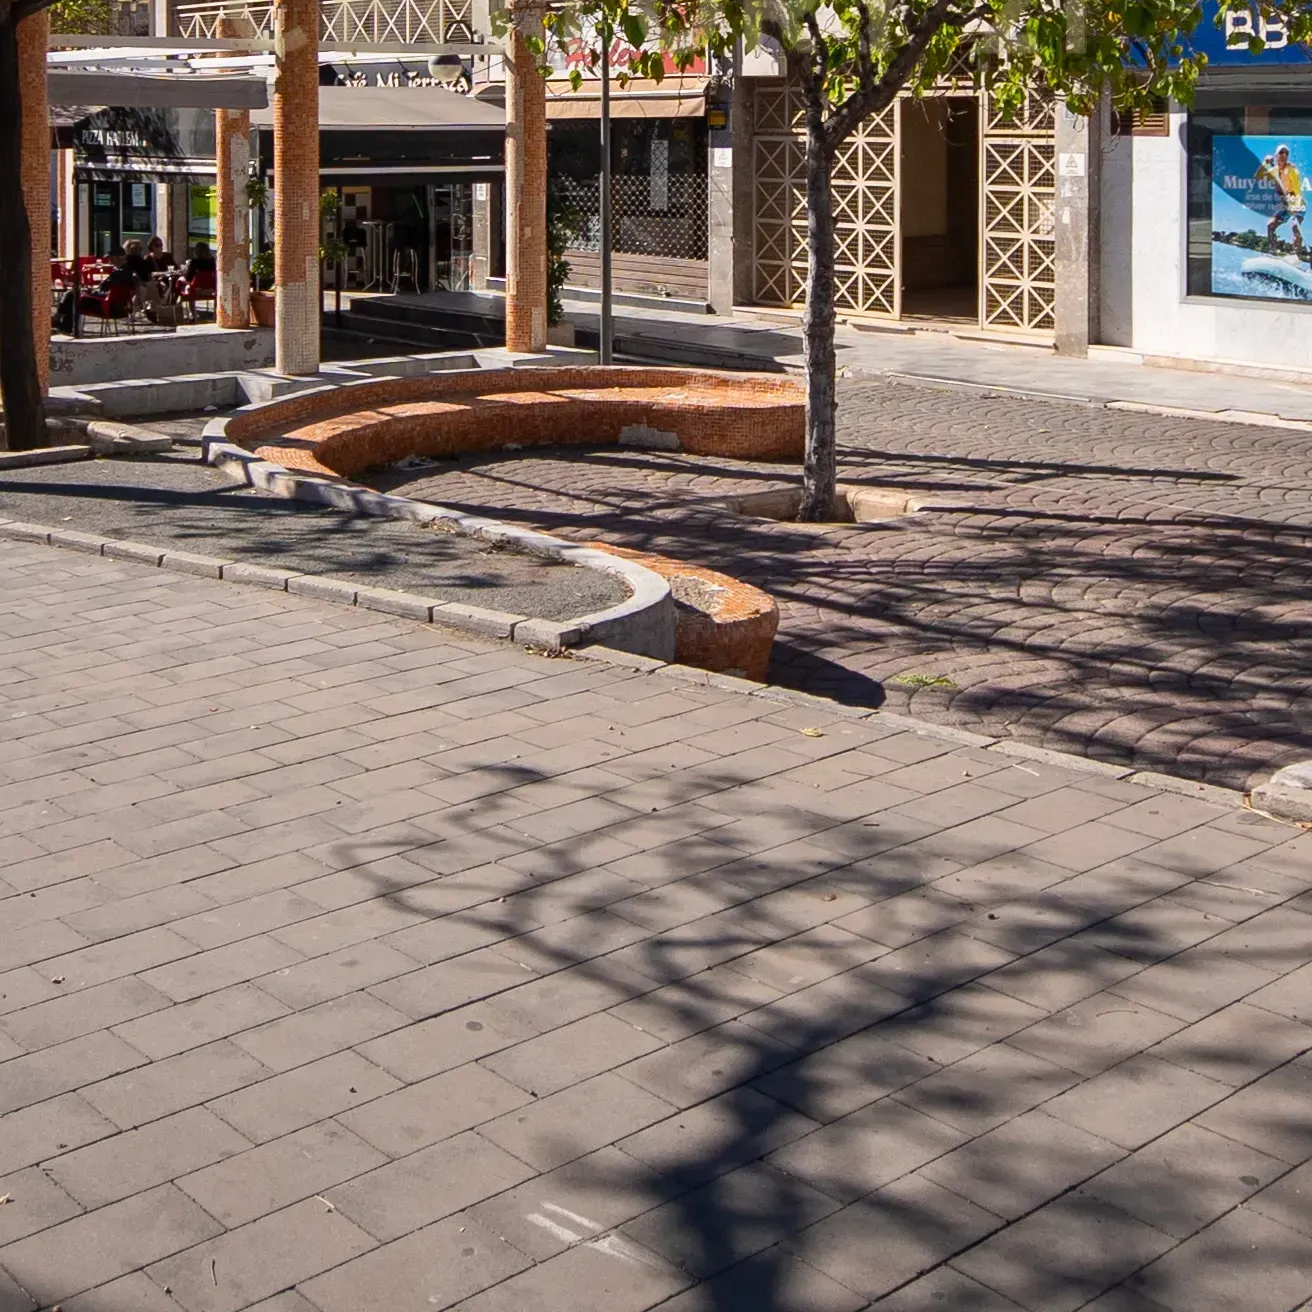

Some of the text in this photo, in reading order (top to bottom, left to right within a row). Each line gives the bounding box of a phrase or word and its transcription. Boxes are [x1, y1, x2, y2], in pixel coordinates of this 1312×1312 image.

[377, 72, 400, 87] Mi
[82, 129, 104, 145] PIZZA
[1223, 175, 1256, 192] Muy
[1257, 175, 1275, 189] de
